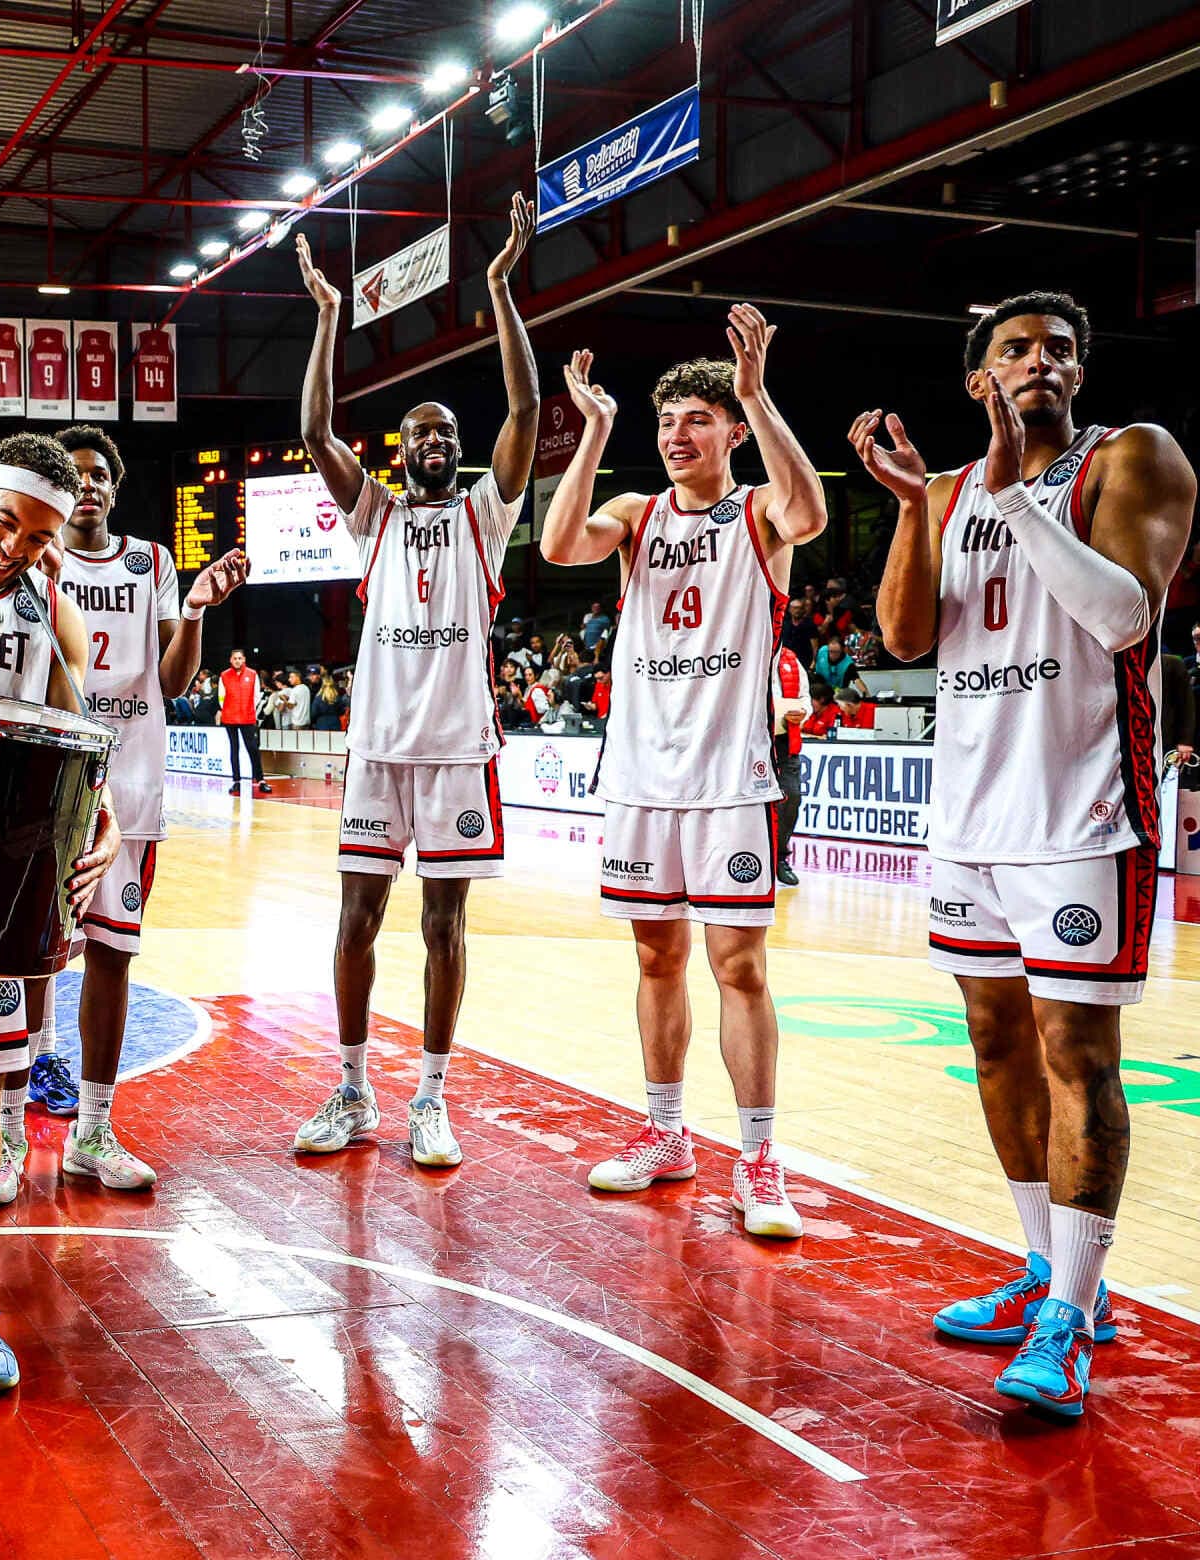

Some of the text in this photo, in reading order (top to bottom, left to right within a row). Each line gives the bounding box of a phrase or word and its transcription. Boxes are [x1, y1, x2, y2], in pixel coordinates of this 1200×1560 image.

[44, 364, 53, 386] 9
[91, 366, 101, 387] 9
[144, 367, 165, 388] 44
[404, 518, 451, 551] CHOLET
[649, 528, 720, 570] CHOLET
[62, 582, 137, 614] CHOLET
[417, 568, 430, 603] 6
[663, 585, 703, 631] 49
[984, 576, 1008, 632] 0
[92, 631, 111, 671] 2
[392, 622, 469, 648] solengie
[648, 647, 742, 677] solengie
[568, 772, 586, 798] VS
[799, 754, 934, 805] B/CHALO
[343, 817, 393, 832] MILLET
[803, 803, 920, 838] 17 OCTOBRE
[602, 856, 654, 874] MILLET
